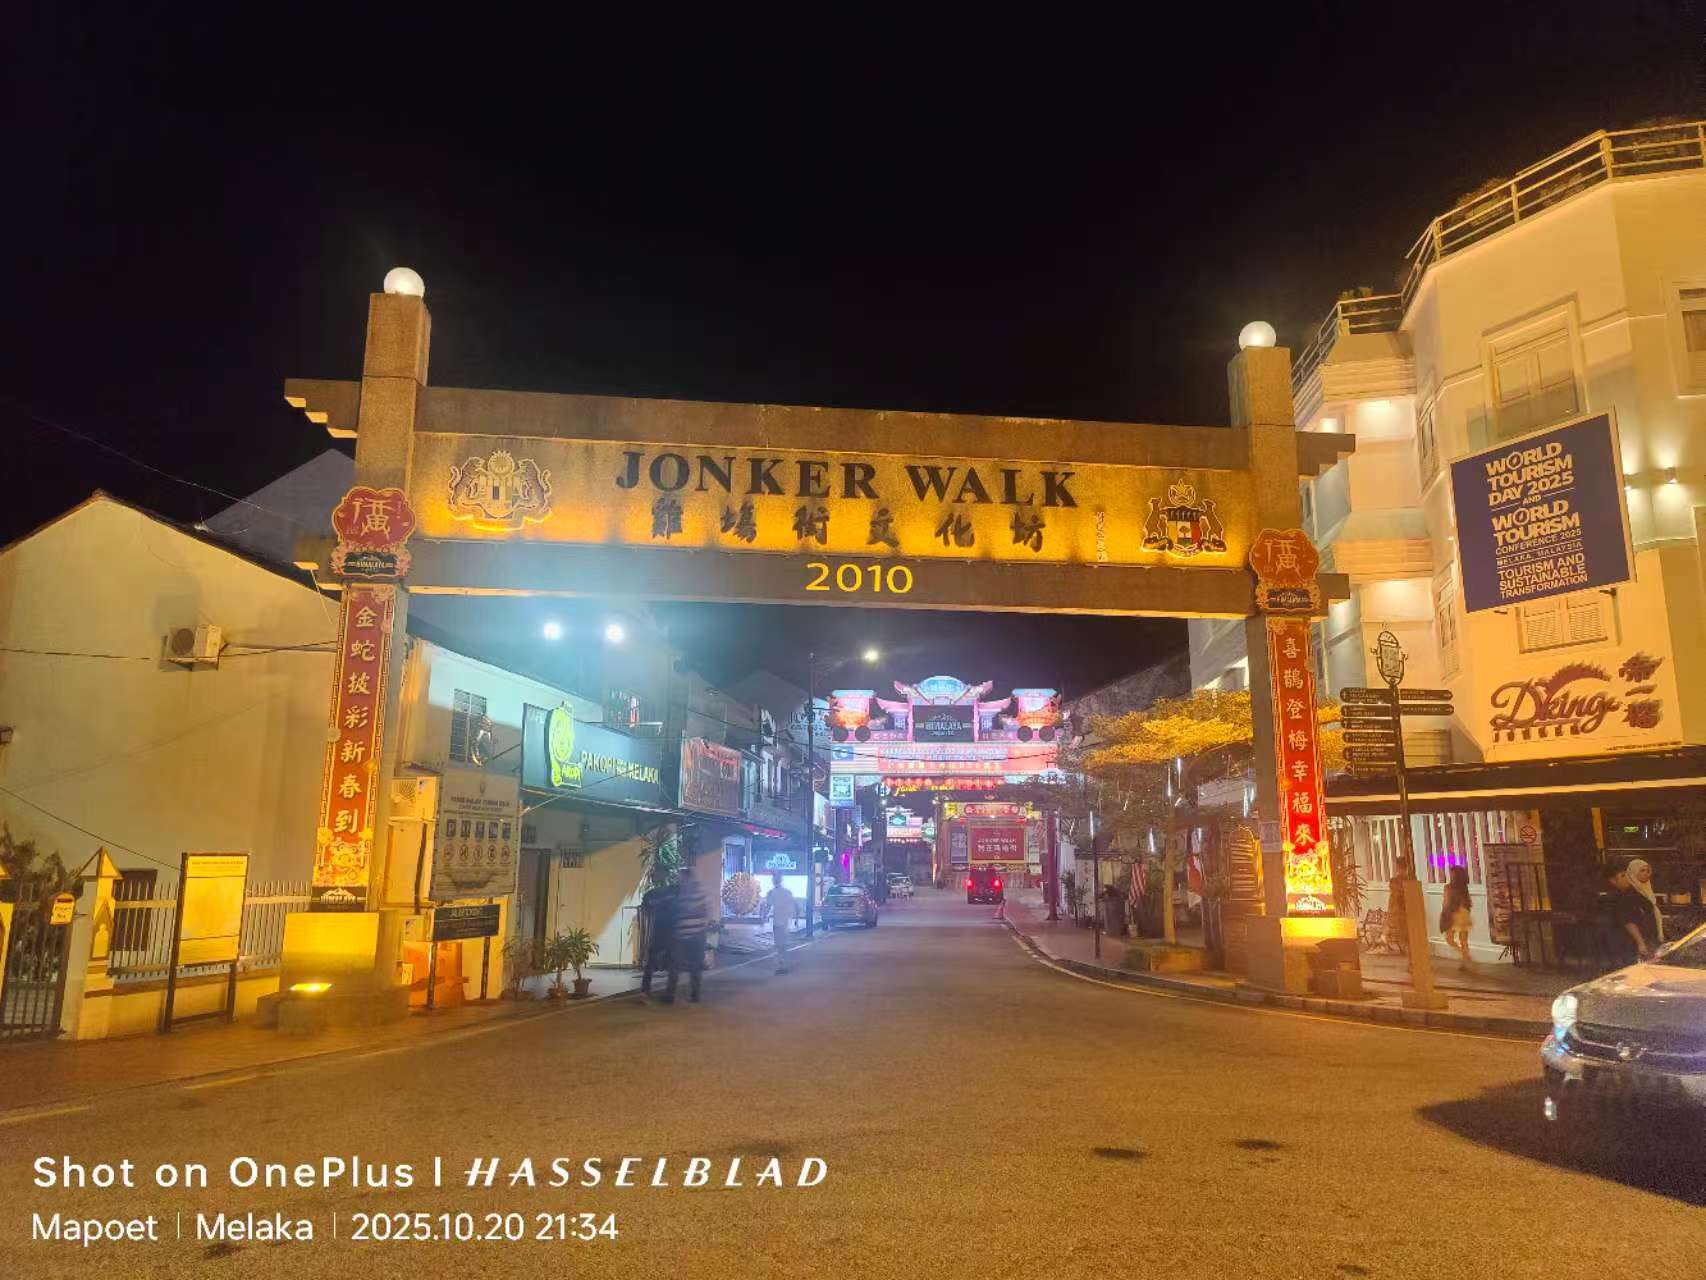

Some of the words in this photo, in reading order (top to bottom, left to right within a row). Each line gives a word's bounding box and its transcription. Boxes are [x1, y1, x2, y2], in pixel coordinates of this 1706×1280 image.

[1485, 442, 1563, 476] WORLD
[1487, 454, 1573, 490] TOURISM
[616, 451, 879, 499] JONKER
[904, 465, 1078, 507] WALK
[1488, 485, 1522, 506] DAY
[1528, 472, 1574, 495] 2025
[1523, 494, 1542, 505] AND
[1491, 500, 1569, 531] WORLD
[1494, 512, 1580, 546] TOURISM
[1496, 534, 1558, 555] CONFERENCE
[1560, 529, 1581, 541] 2025
[1537, 541, 1582, 557] MALAYSIA
[805, 562, 913, 593] 2010
[1497, 559, 1555, 580] TOURISM
[1557, 553, 1585, 568] AND
[1499, 564, 1586, 590] SUSTAINABLE
[1500, 574, 1588, 599] TRANSFORMATION
[334, 606, 378, 834] 金蛇披彩新春到
[628, 761, 659, 784] MELAKA
